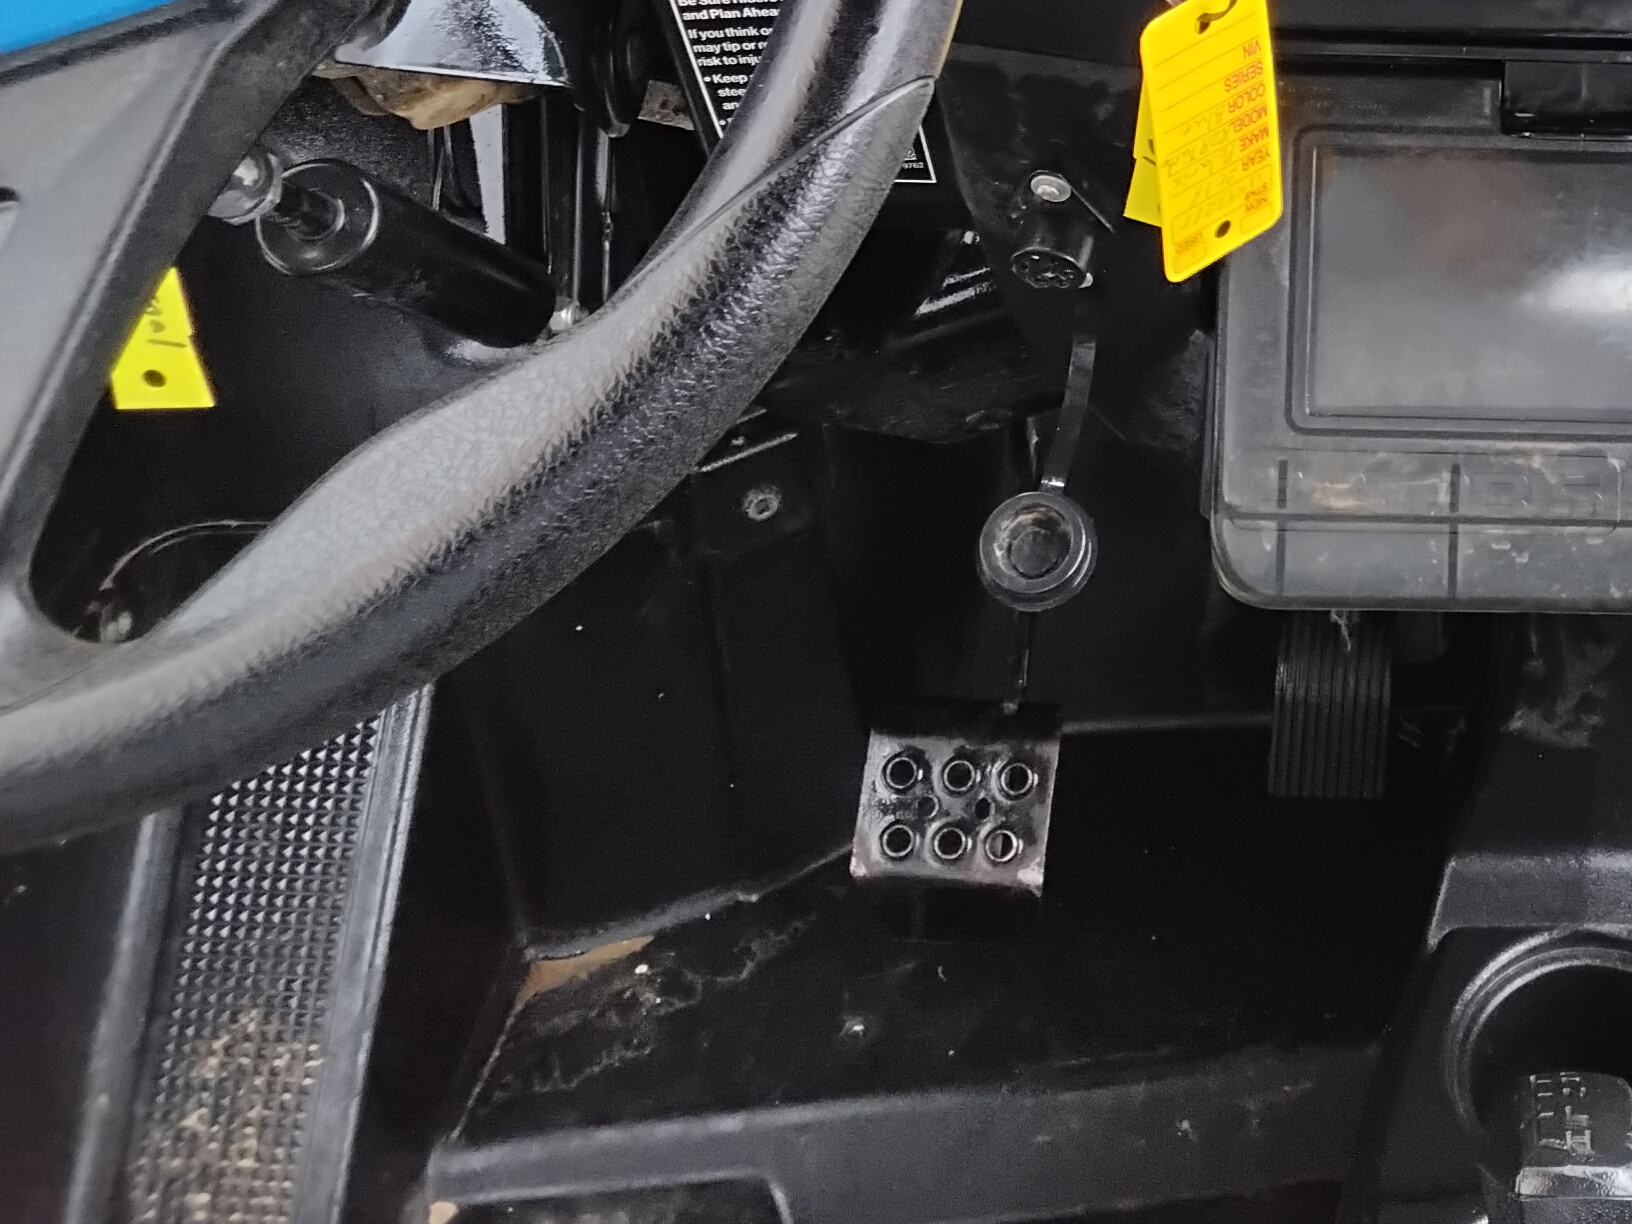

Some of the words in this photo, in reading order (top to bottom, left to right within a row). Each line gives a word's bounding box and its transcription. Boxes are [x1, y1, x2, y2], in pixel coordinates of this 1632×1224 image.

[682, 9, 709, 21] and
[709, 8, 741, 20] Plan
[742, 6, 780, 18] Ahea
[687, 29, 698, 39] If
[698, 30, 725, 41] you
[724, 26, 759, 38] think
[693, 44, 722, 54] may
[722, 41, 741, 52] tip
[742, 41, 757, 51] or
[1242, 39, 1262, 60] VIN
[697, 56, 723, 67] risk
[722, 55, 738, 66] to
[712, 74, 748, 84] Keep
[1223, 60, 1264, 93] SERIES
[1227, 82, 1266, 114] COLOR
[1230, 103, 1268, 134] MODEL
[1239, 125, 1269, 153] MAKE
[1241, 145, 1271, 172] YEAR
